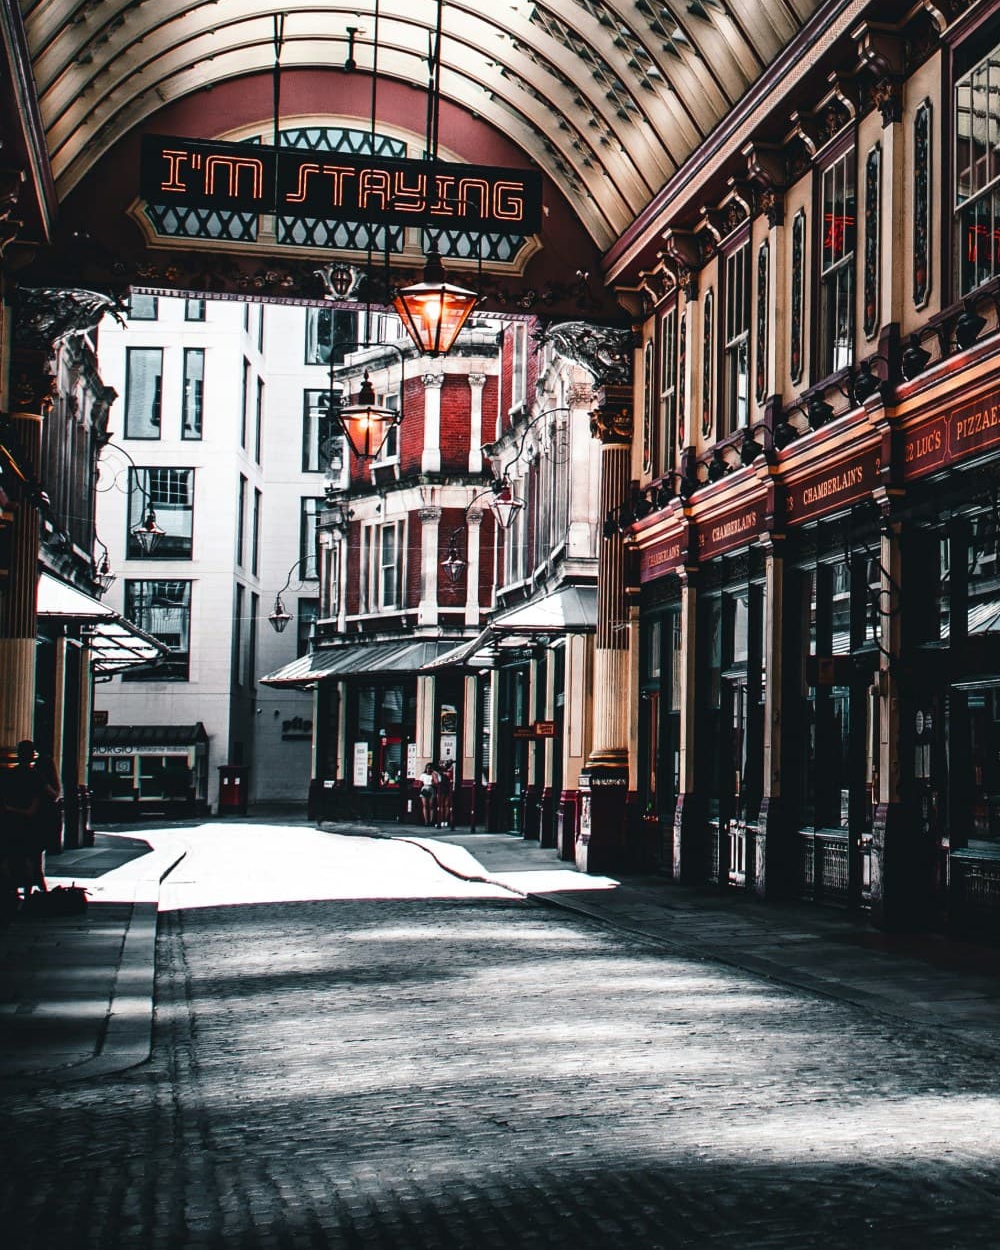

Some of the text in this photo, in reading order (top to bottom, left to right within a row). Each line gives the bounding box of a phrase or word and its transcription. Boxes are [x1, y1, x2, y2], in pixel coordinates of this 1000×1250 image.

[286, 162, 524, 221] STAYING
[916, 429, 941, 458] LUC'S
[803, 466, 863, 505] CHAMBERLAIN'S
[712, 512, 757, 542] CHAMBERLAIN'S
